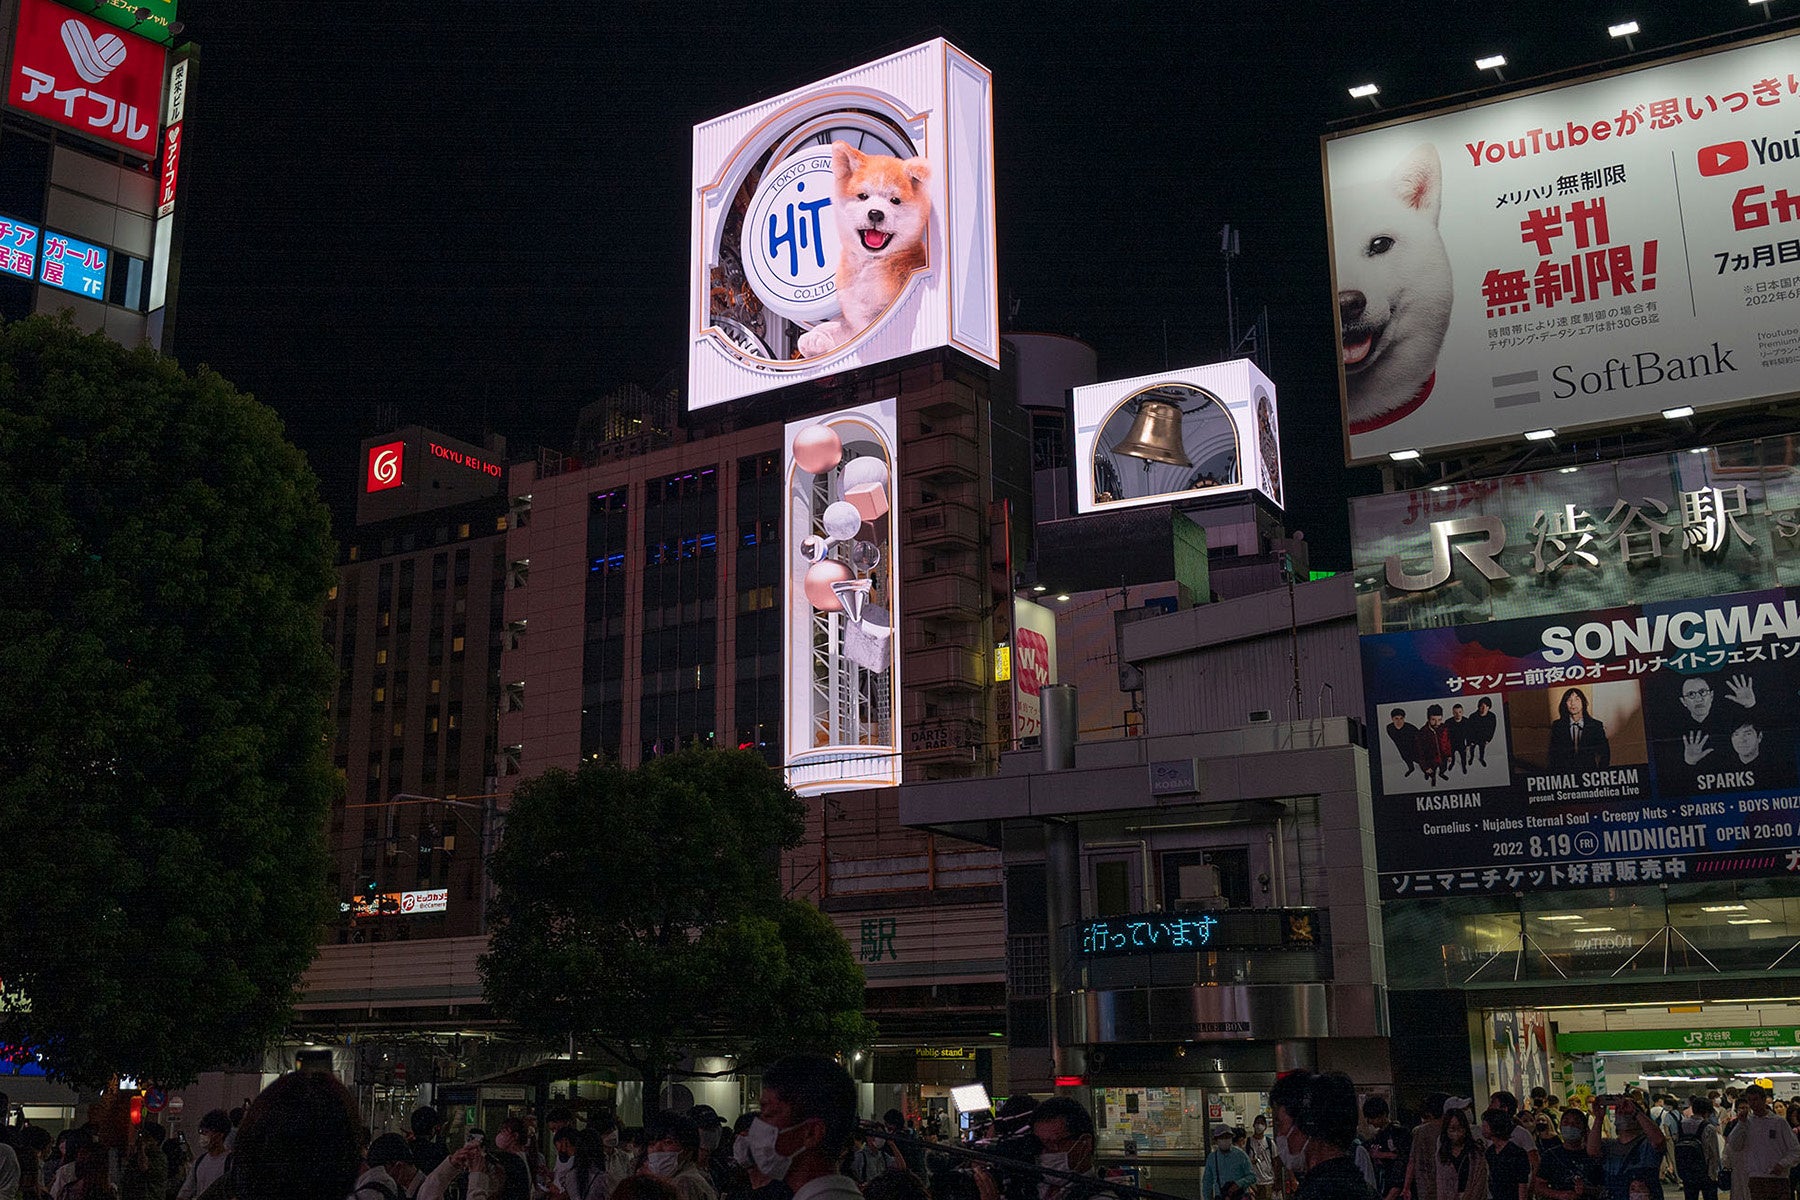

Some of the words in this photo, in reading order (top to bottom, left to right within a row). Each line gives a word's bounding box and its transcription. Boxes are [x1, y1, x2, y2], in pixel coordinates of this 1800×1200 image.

[20, 66, 149, 140] アイフル
[1751, 130, 1800, 165] You
[163, 142, 177, 203] アイフル
[770, 163, 806, 192] TOKYO
[811, 160, 832, 169] GIN
[1495, 164, 1627, 208] メリハリ無制限
[1520, 196, 1611, 256] ギガ
[45, 236, 105, 271] ガール
[82, 276, 103, 295] 7F
[1481, 240, 1659, 319] 無制限!
[1552, 342, 1738, 400] SoftBank
[428, 442, 463, 464] TOKYU
[465, 455, 481, 471] REI
[1386, 515, 1511, 592] JR
[1529, 484, 1757, 573] 渋谷駅
[912, 729, 948, 742] DARTS
[1154, 777, 1192, 790] KOBAN
[1526, 774, 1580, 793] PRIMAL
[1583, 769, 1639, 789] SCREAM
[1528, 793, 1555, 805] present
[1556, 787, 1620, 802] Screamadelica
[1622, 785, 1640, 797] Live
[1697, 771, 1754, 790] SPARKS
[1416, 792, 1482, 812] KASABIAN
[1423, 821, 1471, 836] Cornelius
[1482, 817, 1524, 833] Nujabes
[1526, 813, 1564, 828] Eternal
[1566, 812, 1590, 825] Soul
[1602, 808, 1640, 826] Creepy
[1643, 806, 1668, 820] Nuts
[1680, 802, 1726, 817] SPARKS
[1738, 798, 1770, 813] BOYS
[1771, 796, 1800, 810] NOIZ
[1493, 841, 1524, 857] 2022
[1529, 833, 1571, 858] 8.19
[1579, 838, 1594, 849] FRI
[1603, 824, 1707, 853] MIDNIGHT
[1716, 825, 1751, 842] OPEN
[1754, 823, 1793, 839] 20:00
[1391, 857, 1687, 894] ソニマニチケット好評販売中
[860, 917, 897, 962] 駅
[941, 1047, 963, 1057] stand
[1683, 1031, 1703, 1044] JR
[1704, 1031, 1732, 1041] 渋谷駅
